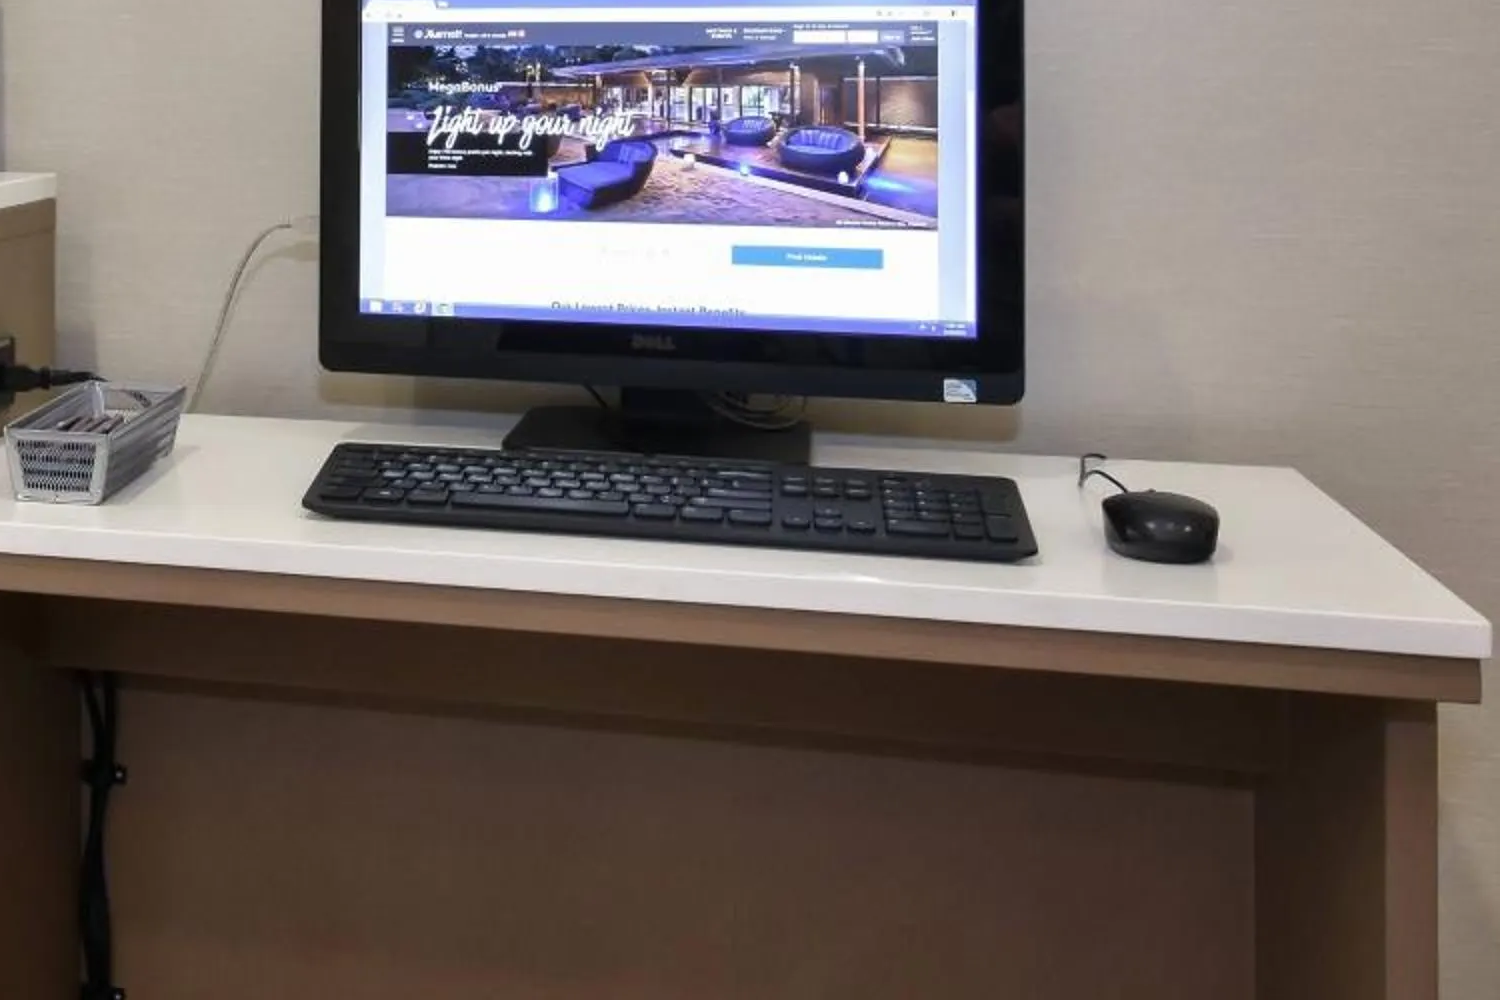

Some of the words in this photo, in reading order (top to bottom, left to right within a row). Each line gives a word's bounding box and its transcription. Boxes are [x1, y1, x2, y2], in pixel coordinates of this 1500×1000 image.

[426, 105, 483, 149] Light
[488, 114, 520, 145] up
[518, 115, 575, 150] your
[578, 107, 636, 151] night
